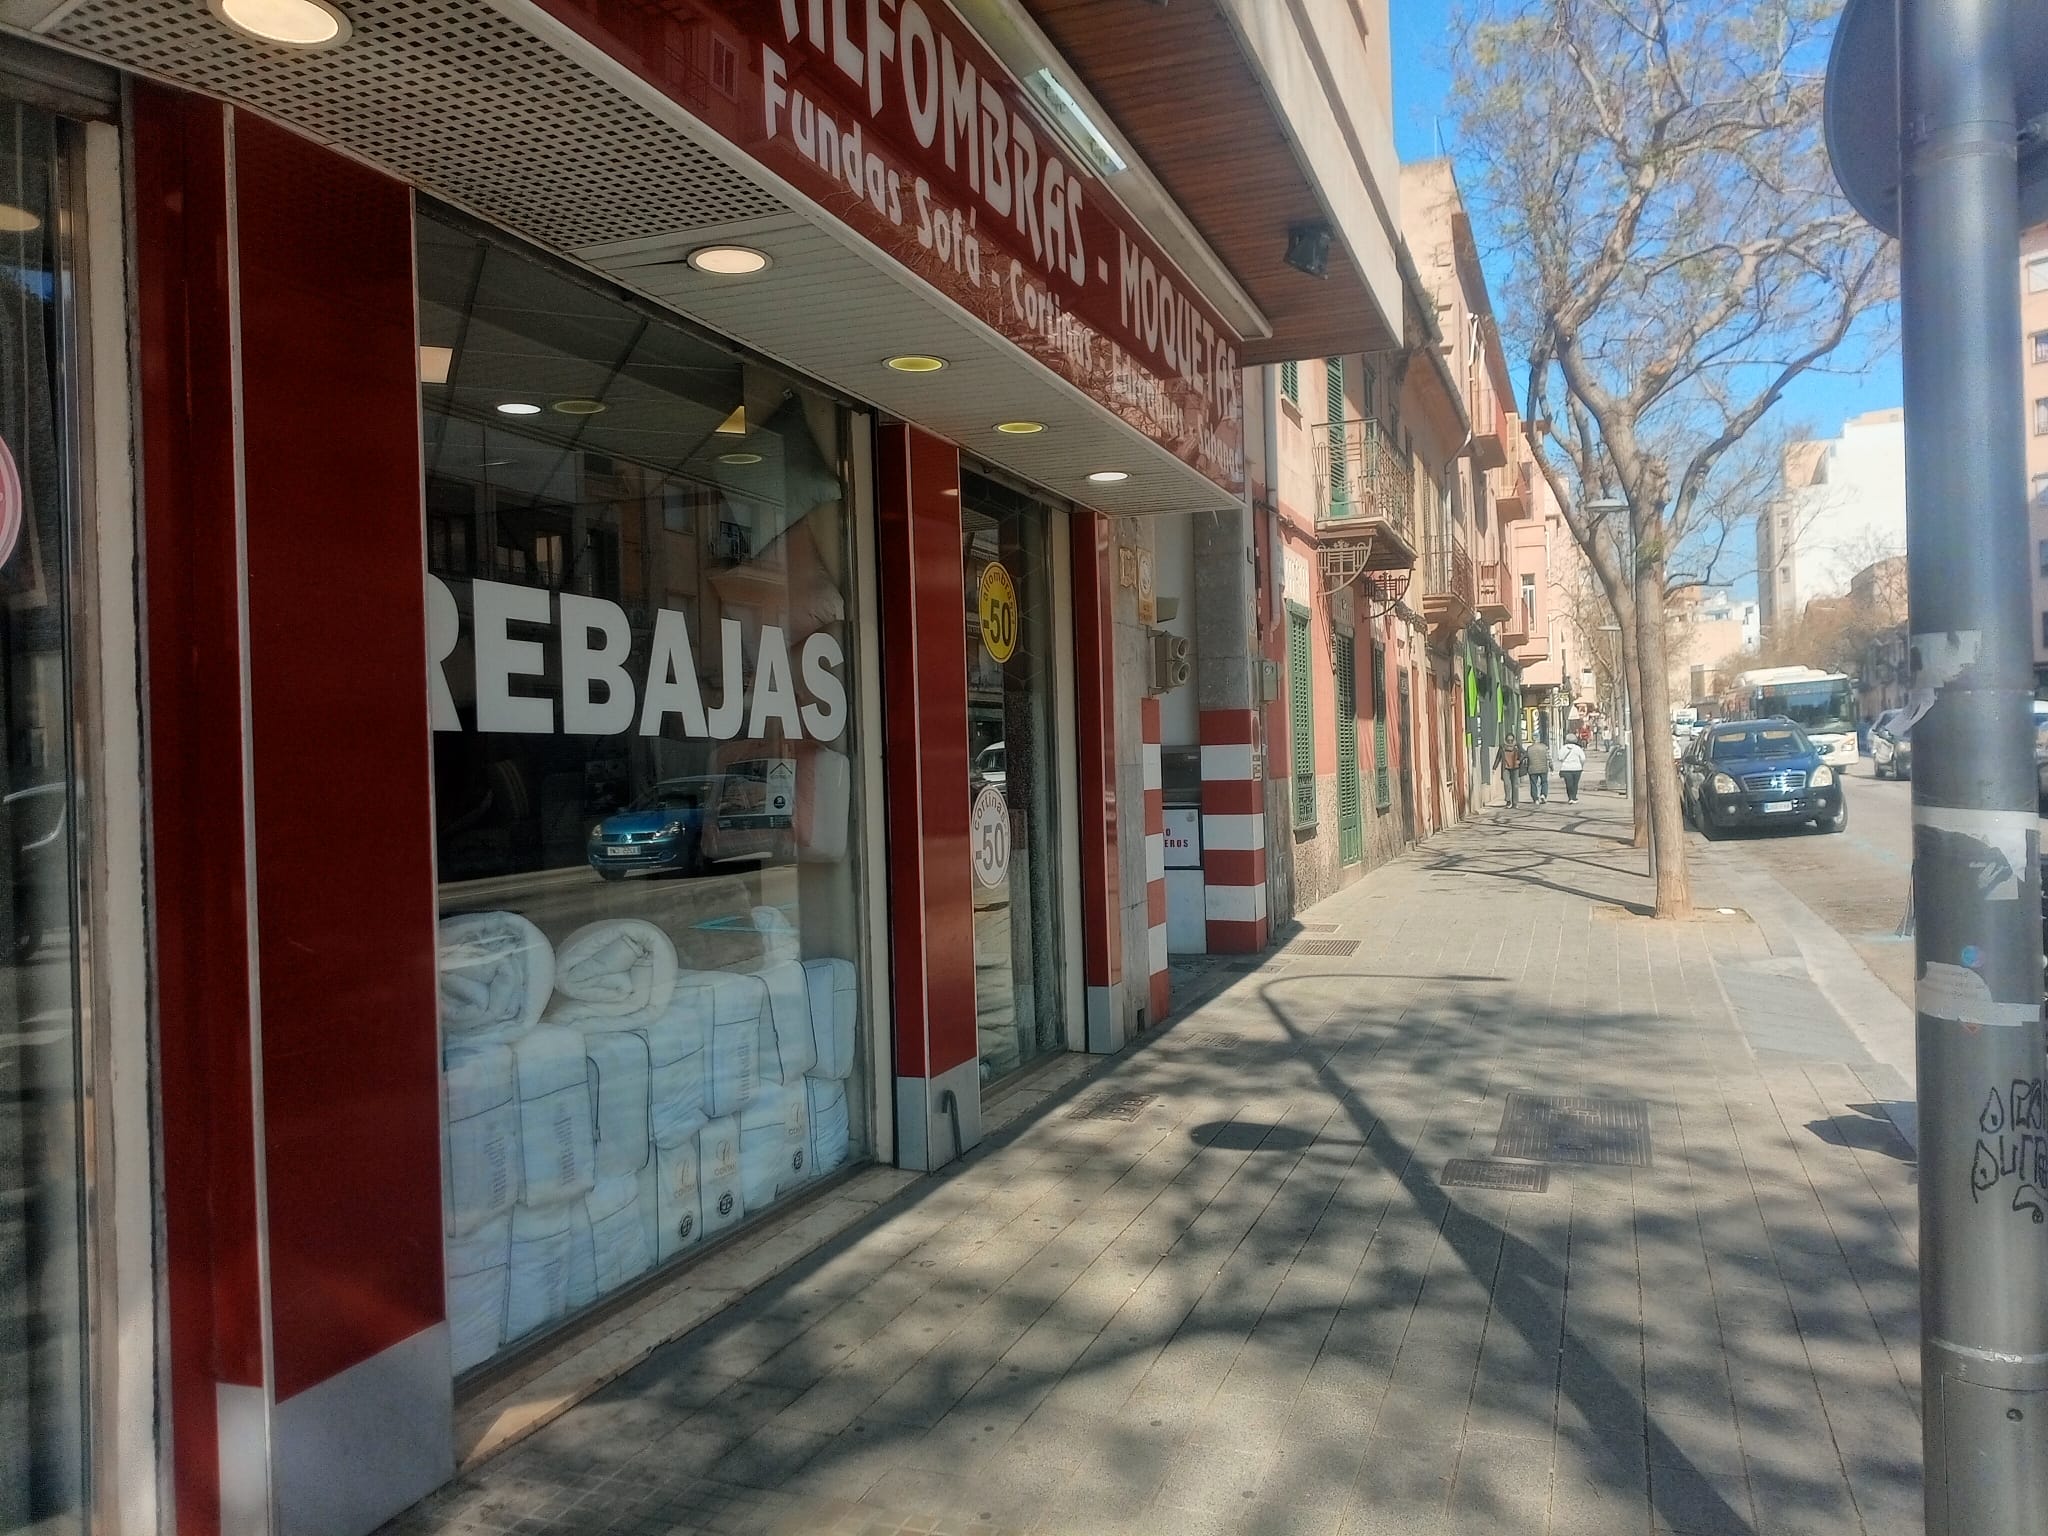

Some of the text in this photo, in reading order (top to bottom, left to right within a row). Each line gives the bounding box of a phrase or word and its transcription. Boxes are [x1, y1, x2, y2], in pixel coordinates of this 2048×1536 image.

[763, 43, 902, 226] Fundas
[915, 176, 981, 288] Sofá
[1010, 258, 1093, 372] Cortinas
[780, 0, 1085, 286] LFOMBRAS
[1120, 228, 1238, 419] MOQUETAS
